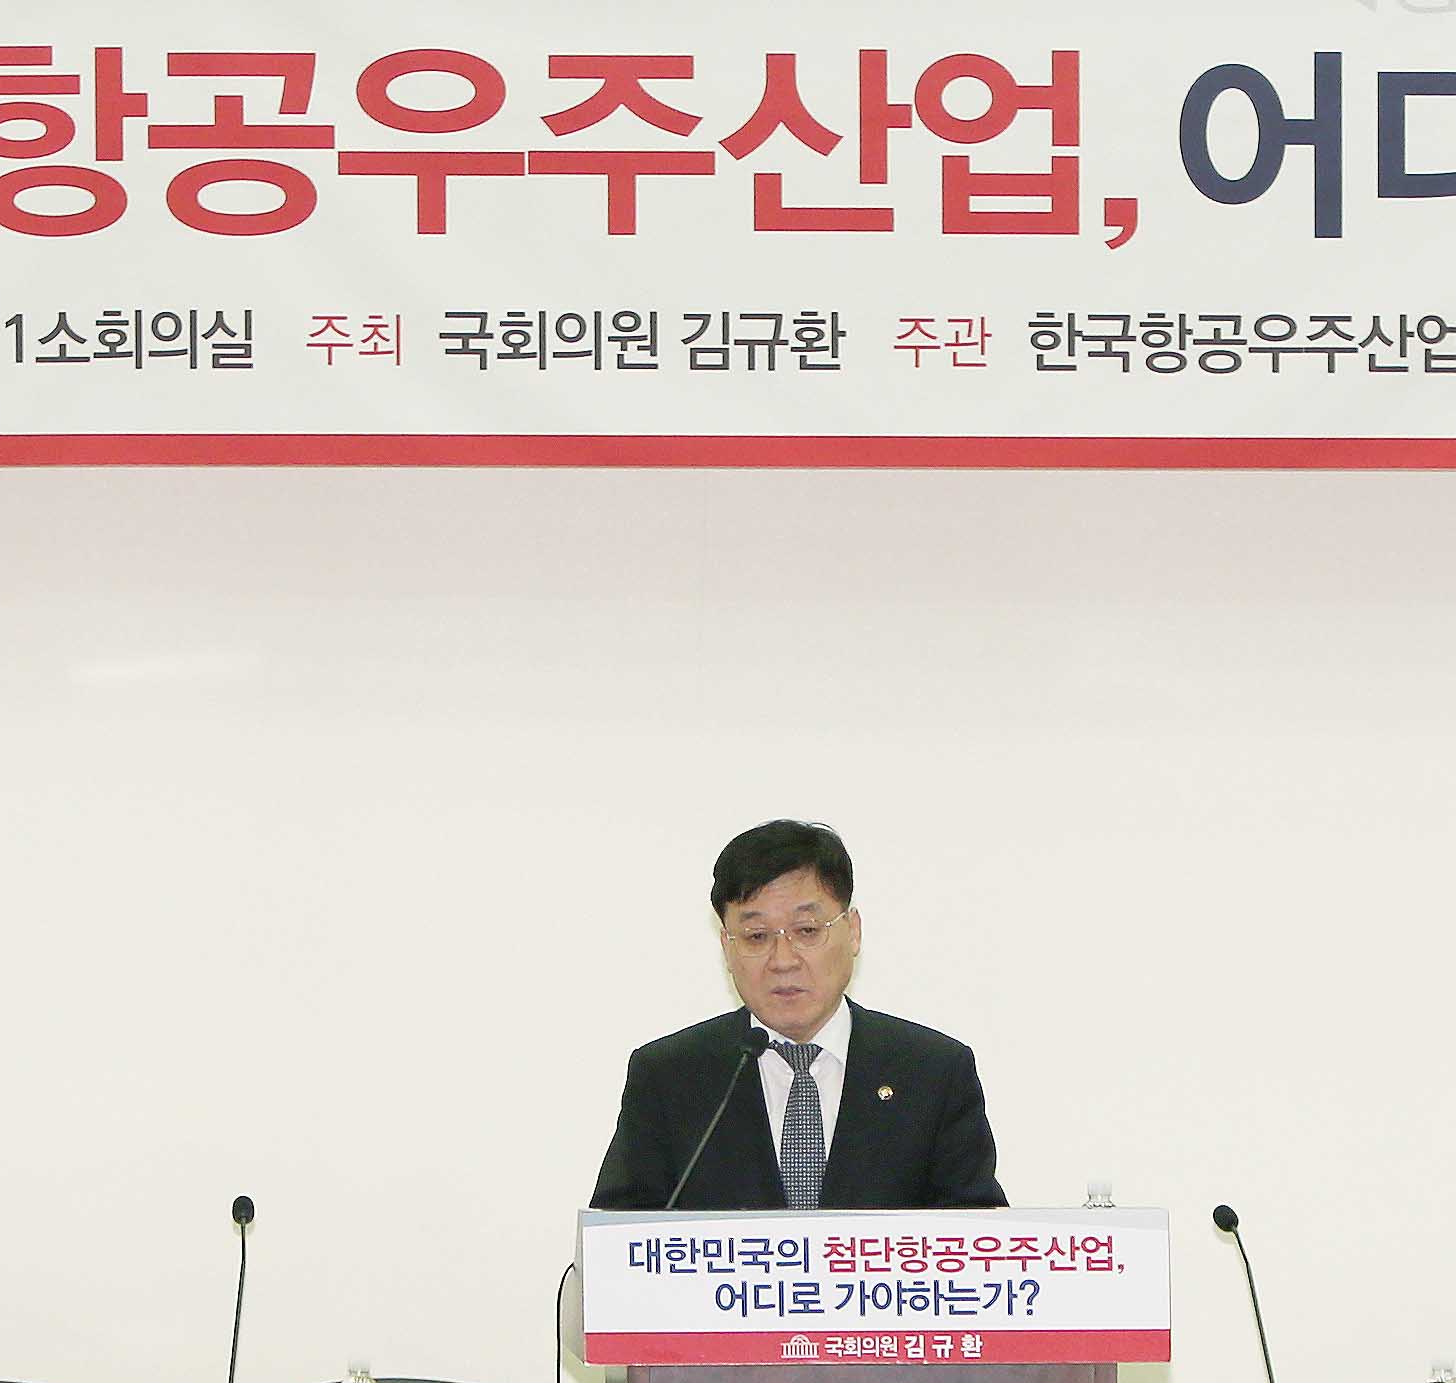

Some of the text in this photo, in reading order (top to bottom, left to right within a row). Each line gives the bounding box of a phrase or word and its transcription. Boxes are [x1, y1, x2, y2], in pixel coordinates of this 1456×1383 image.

[305, 315, 401, 366] 주최
[438, 310, 659, 371] 국회의원
[680, 311, 847, 372] 김규환
[895, 318, 993, 369] 주관
[628, 1235, 1125, 1275] 대한민국의 첨단항공우주산업,
[715, 1279, 1041, 1318] 어디로 가야하는가?
[824, 1335, 898, 1358] 국회의원
